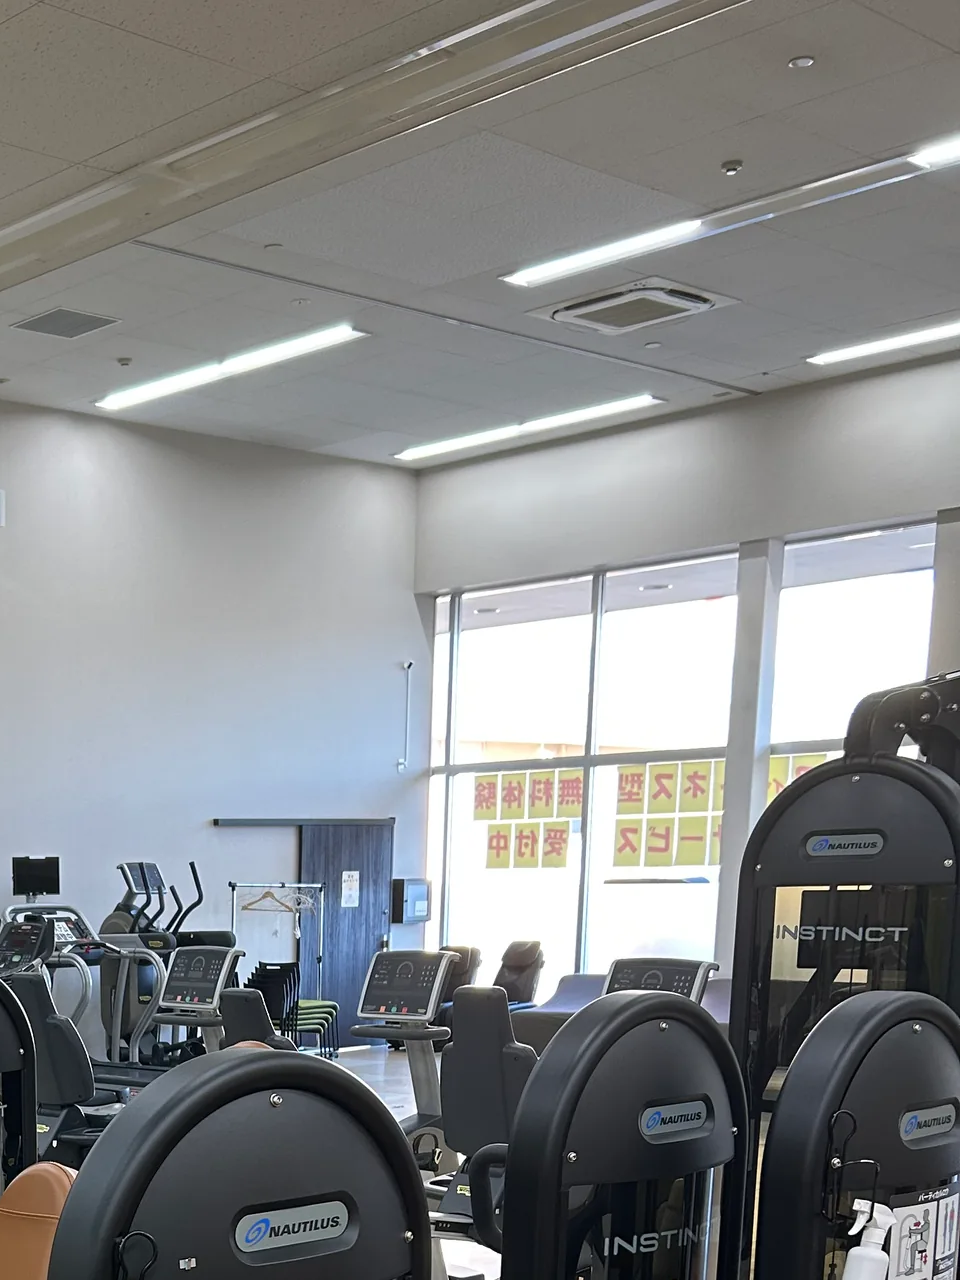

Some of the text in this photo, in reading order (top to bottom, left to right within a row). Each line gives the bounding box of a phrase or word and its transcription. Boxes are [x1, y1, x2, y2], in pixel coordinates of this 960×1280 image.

[828, 841, 878, 850] NAUTILUS
[776, 925, 908, 942] INSTINCT
[660, 1112, 702, 1126] NAUTILUS
[916, 1114, 952, 1130] NAUTILUS
[268, 1216, 341, 1238] NAUTILUS
[603, 1216, 721, 1256] INSTINC
